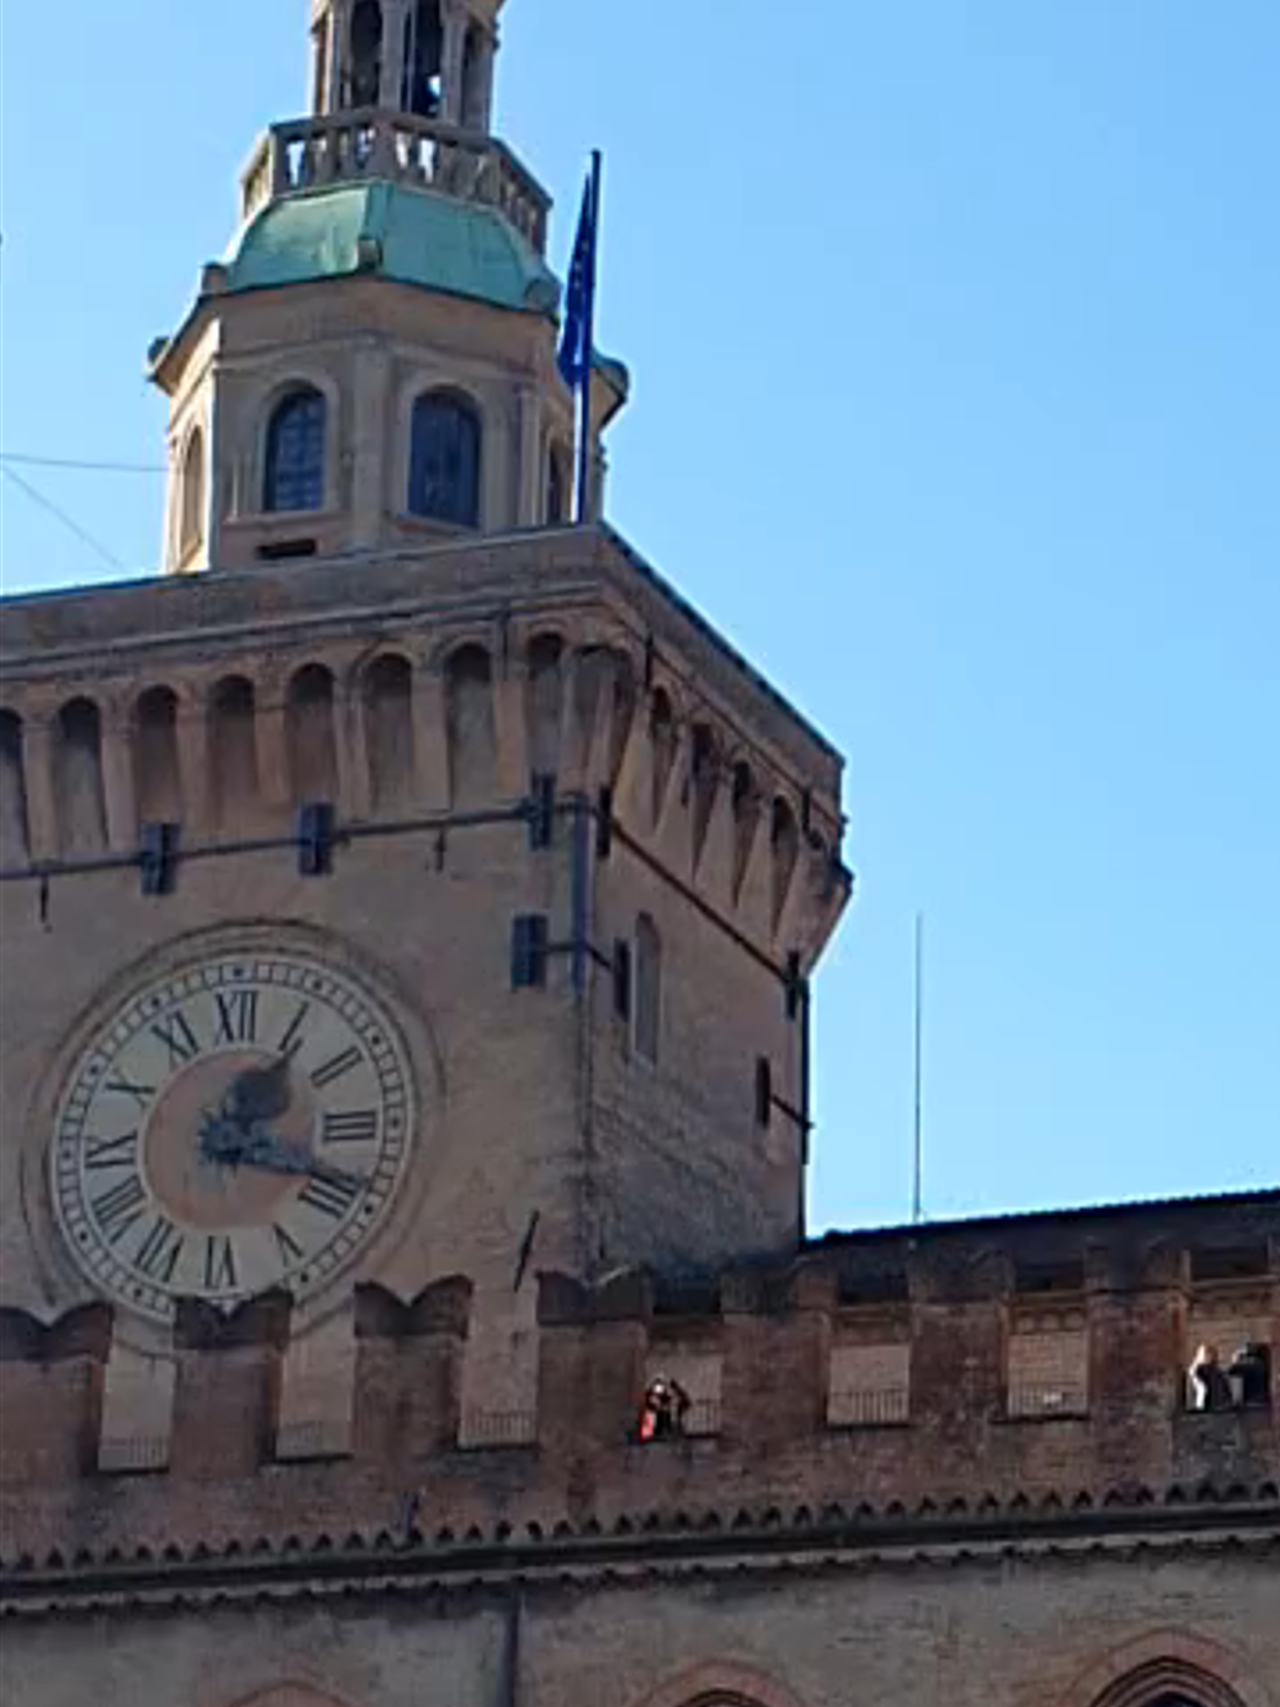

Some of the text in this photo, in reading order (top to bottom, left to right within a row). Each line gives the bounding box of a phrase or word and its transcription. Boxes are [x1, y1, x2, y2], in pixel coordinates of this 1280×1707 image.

[151, 1010, 199, 1069] XI
[215, 989, 259, 1045] XII
[105, 1067, 157, 1110] X
[310, 1045, 364, 1088] II
[323, 1109, 376, 1143] III
[205, 1231, 238, 1289] VI
[272, 1221, 305, 1269] V
